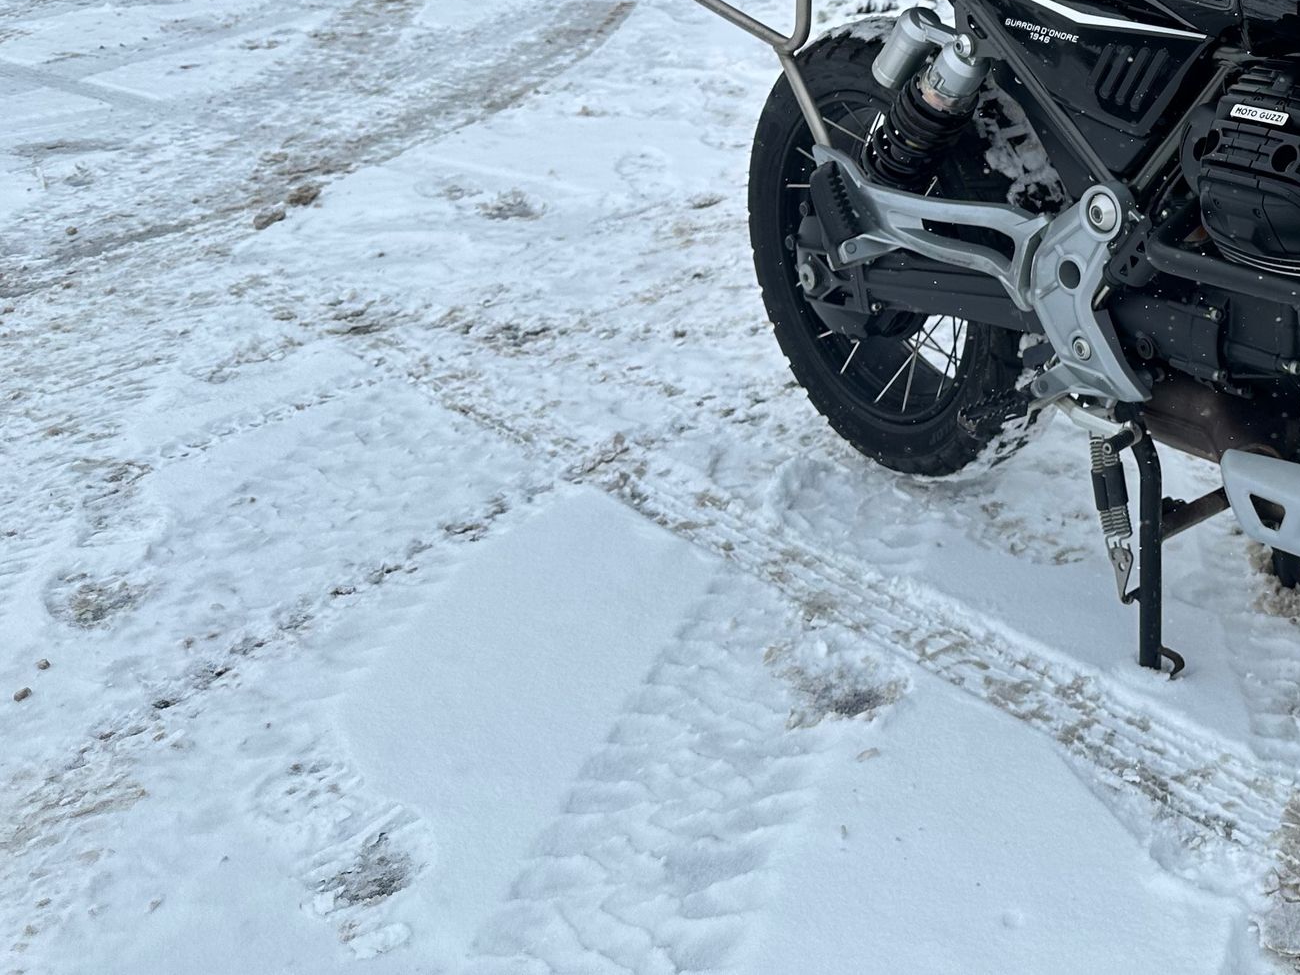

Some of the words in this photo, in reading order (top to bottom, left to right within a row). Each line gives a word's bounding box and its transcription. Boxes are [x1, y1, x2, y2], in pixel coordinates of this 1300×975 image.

[1005, 18, 1041, 33] GUARDIA
[1040, 27, 1079, 43] D'ONORE
[1030, 32, 1050, 43] 1946
[1235, 107, 1258, 117] MOTO
[1259, 111, 1285, 123] GUZZI
